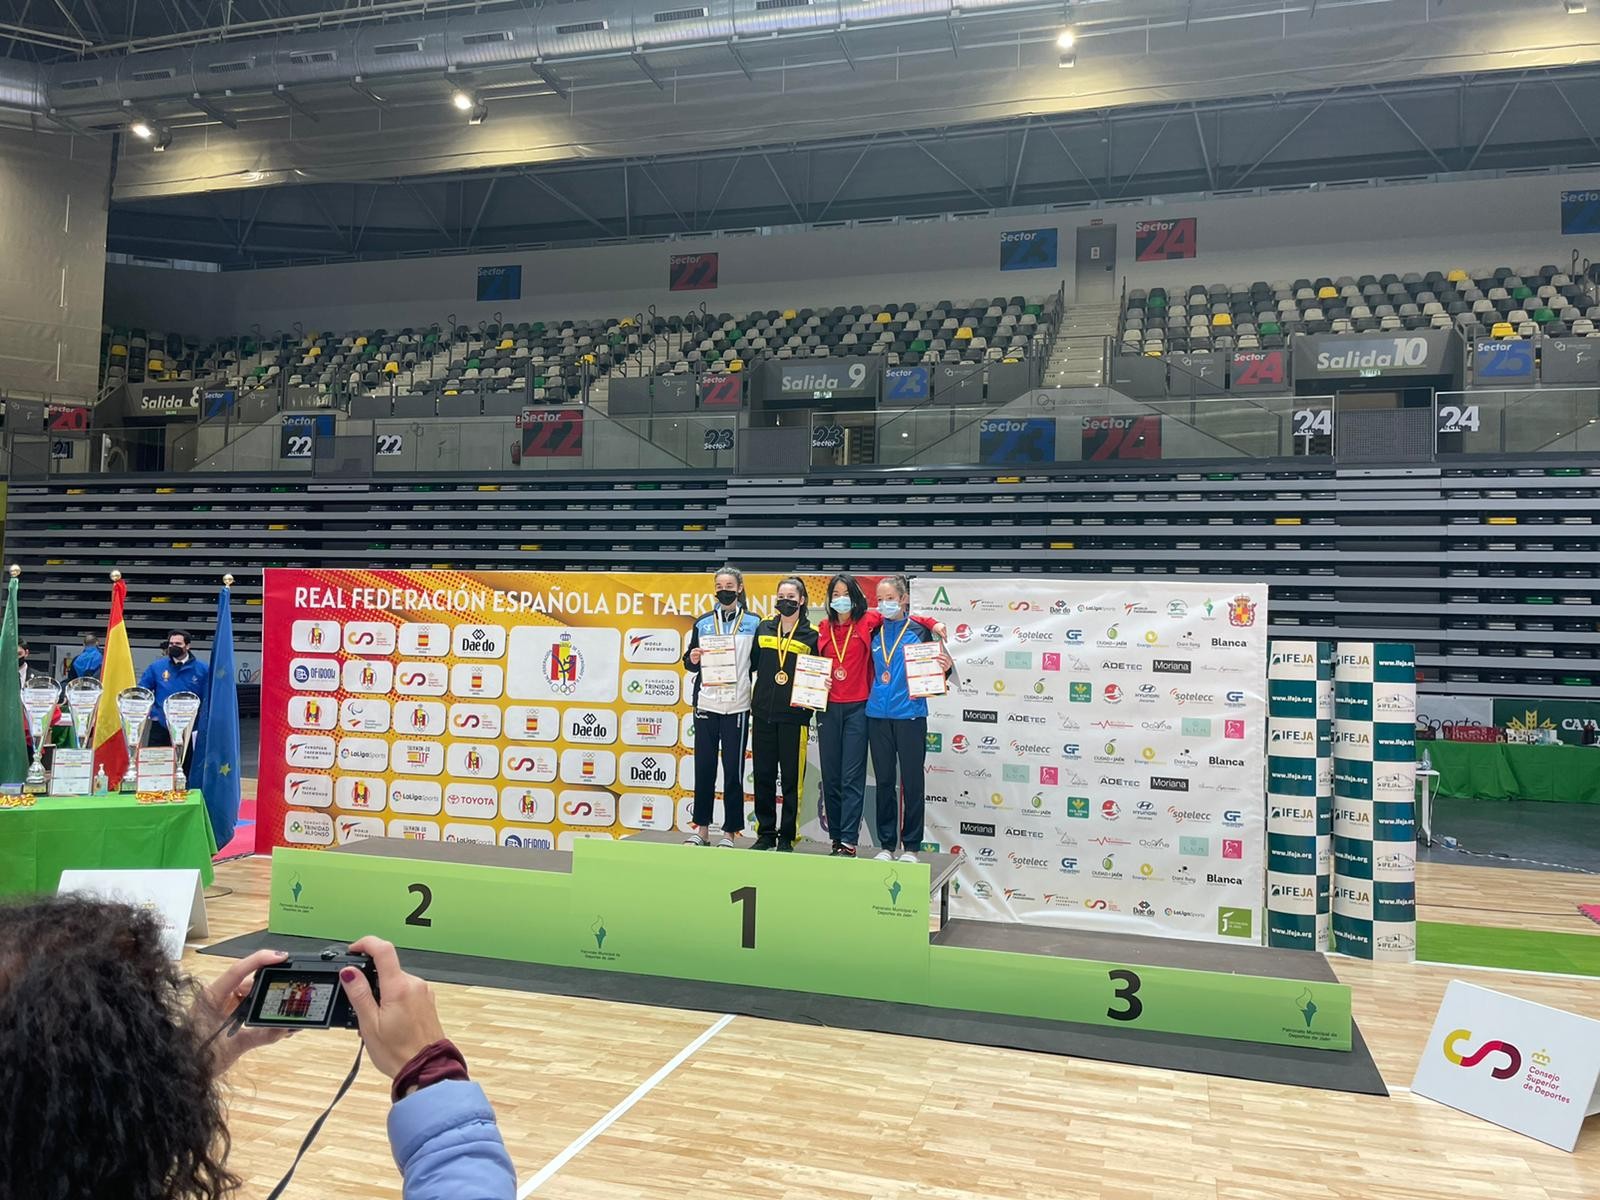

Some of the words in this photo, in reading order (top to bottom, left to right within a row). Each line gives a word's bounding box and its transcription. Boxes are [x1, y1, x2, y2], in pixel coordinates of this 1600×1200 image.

[1561, 192, 1600, 203] Secto
[1135, 221, 1175, 232] Sector
[1000, 232, 1037, 243] Sector
[1136, 218, 1197, 262] 24
[669, 255, 701, 265] Sector
[478, 267, 507, 277] Sector
[670, 253, 718, 290] 22
[1317, 351, 1391, 369] Salida
[1393, 337, 1428, 367] 10
[1478, 343, 1512, 352] Sector
[1234, 353, 1266, 362] Sector
[1480, 342, 1532, 377] 25
[886, 369, 912, 378] Sector
[1235, 351, 1283, 385] 24
[702, 376, 726, 384] Sector
[782, 374, 838, 391] Salida
[848, 363, 866, 389] 9
[703, 375, 740, 404] 22
[141, 395, 184, 409] Salida
[48, 404, 75, 413] Sector
[50, 408, 87, 432] 20
[281, 416, 316, 426] Sector
[522, 410, 562, 423] Sector
[1439, 405, 1481, 432] 24
[980, 420, 1028, 433] Sector
[1082, 417, 1133, 431] Sector
[1293, 409, 1332, 436] 24
[523, 419, 583, 457] 22
[704, 429, 734, 450] 23
[813, 425, 845, 448] 23
[1083, 416, 1162, 460] 24
[287, 436, 312, 457] 22
[377, 434, 402, 456] 22
[704, 442, 727, 450] Sector
[812, 439, 836, 448] Sector
[294, 586, 347, 611] REAL
[350, 583, 488, 613] FEDERACIÓN
[493, 586, 610, 615] ESPAÑOLA
[616, 592, 645, 616] DE
[1016, 630, 1053, 640] sotelecc
[1211, 637, 1246, 647] Blanca
[1282, 654, 1314, 664] IFEJA
[1341, 655, 1370, 665] IFEJA
[1102, 660, 1142, 670] ADETEC
[1154, 660, 1190, 671] Moriana
[238, 668, 252, 684] CSD
[1174, 692, 1213, 702] sotelecc
[1226, 691, 1244, 702] GF
[1272, 695, 1313, 704] www.ifeja.org
[964, 711, 997, 721] Moriana
[1007, 714, 1046, 724] ADETEC
[1282, 731, 1314, 742] IFEJA
[1341, 733, 1370, 743] IFEJA
[1015, 743, 1051, 754] sotelecc
[1063, 743, 1080, 754] GF
[1209, 756, 1244, 767] Blanca
[1100, 777, 1140, 787] ADETEC
[1271, 773, 1313, 782] www.ifeja.org
[1152, 778, 1187, 789] Moriana
[461, 797, 495, 806] TOYOTA
[925, 795, 947, 804] anca
[1172, 811, 1211, 821] sotelecc
[1224, 811, 1241, 821] GF
[1282, 808, 1313, 819] IFEJA
[1341, 810, 1370, 822] IFEJA
[961, 823, 994, 834] Moriana
[1005, 828, 1044, 838] ADETEC
[1271, 850, 1313, 859] www.ifeja.org
[1012, 857, 1048, 868] sotelecc
[1061, 858, 1078, 869] GF
[1207, 874, 1242, 885] Blanca
[1282, 886, 1313, 898] IFEJA
[1340, 888, 1370, 902] IFEJA
[405, 883, 432, 928] 2
[730, 886, 757, 949] 1
[1271, 928, 1313, 938] www.ifeja.org
[1107, 969, 1143, 1021] 3
[1528, 1066, 1560, 1085] Consejo
[1526, 1074, 1560, 1091] Superior
[1523, 1082, 1533, 1091] de
[1534, 1085, 1571, 1104] Deportes
